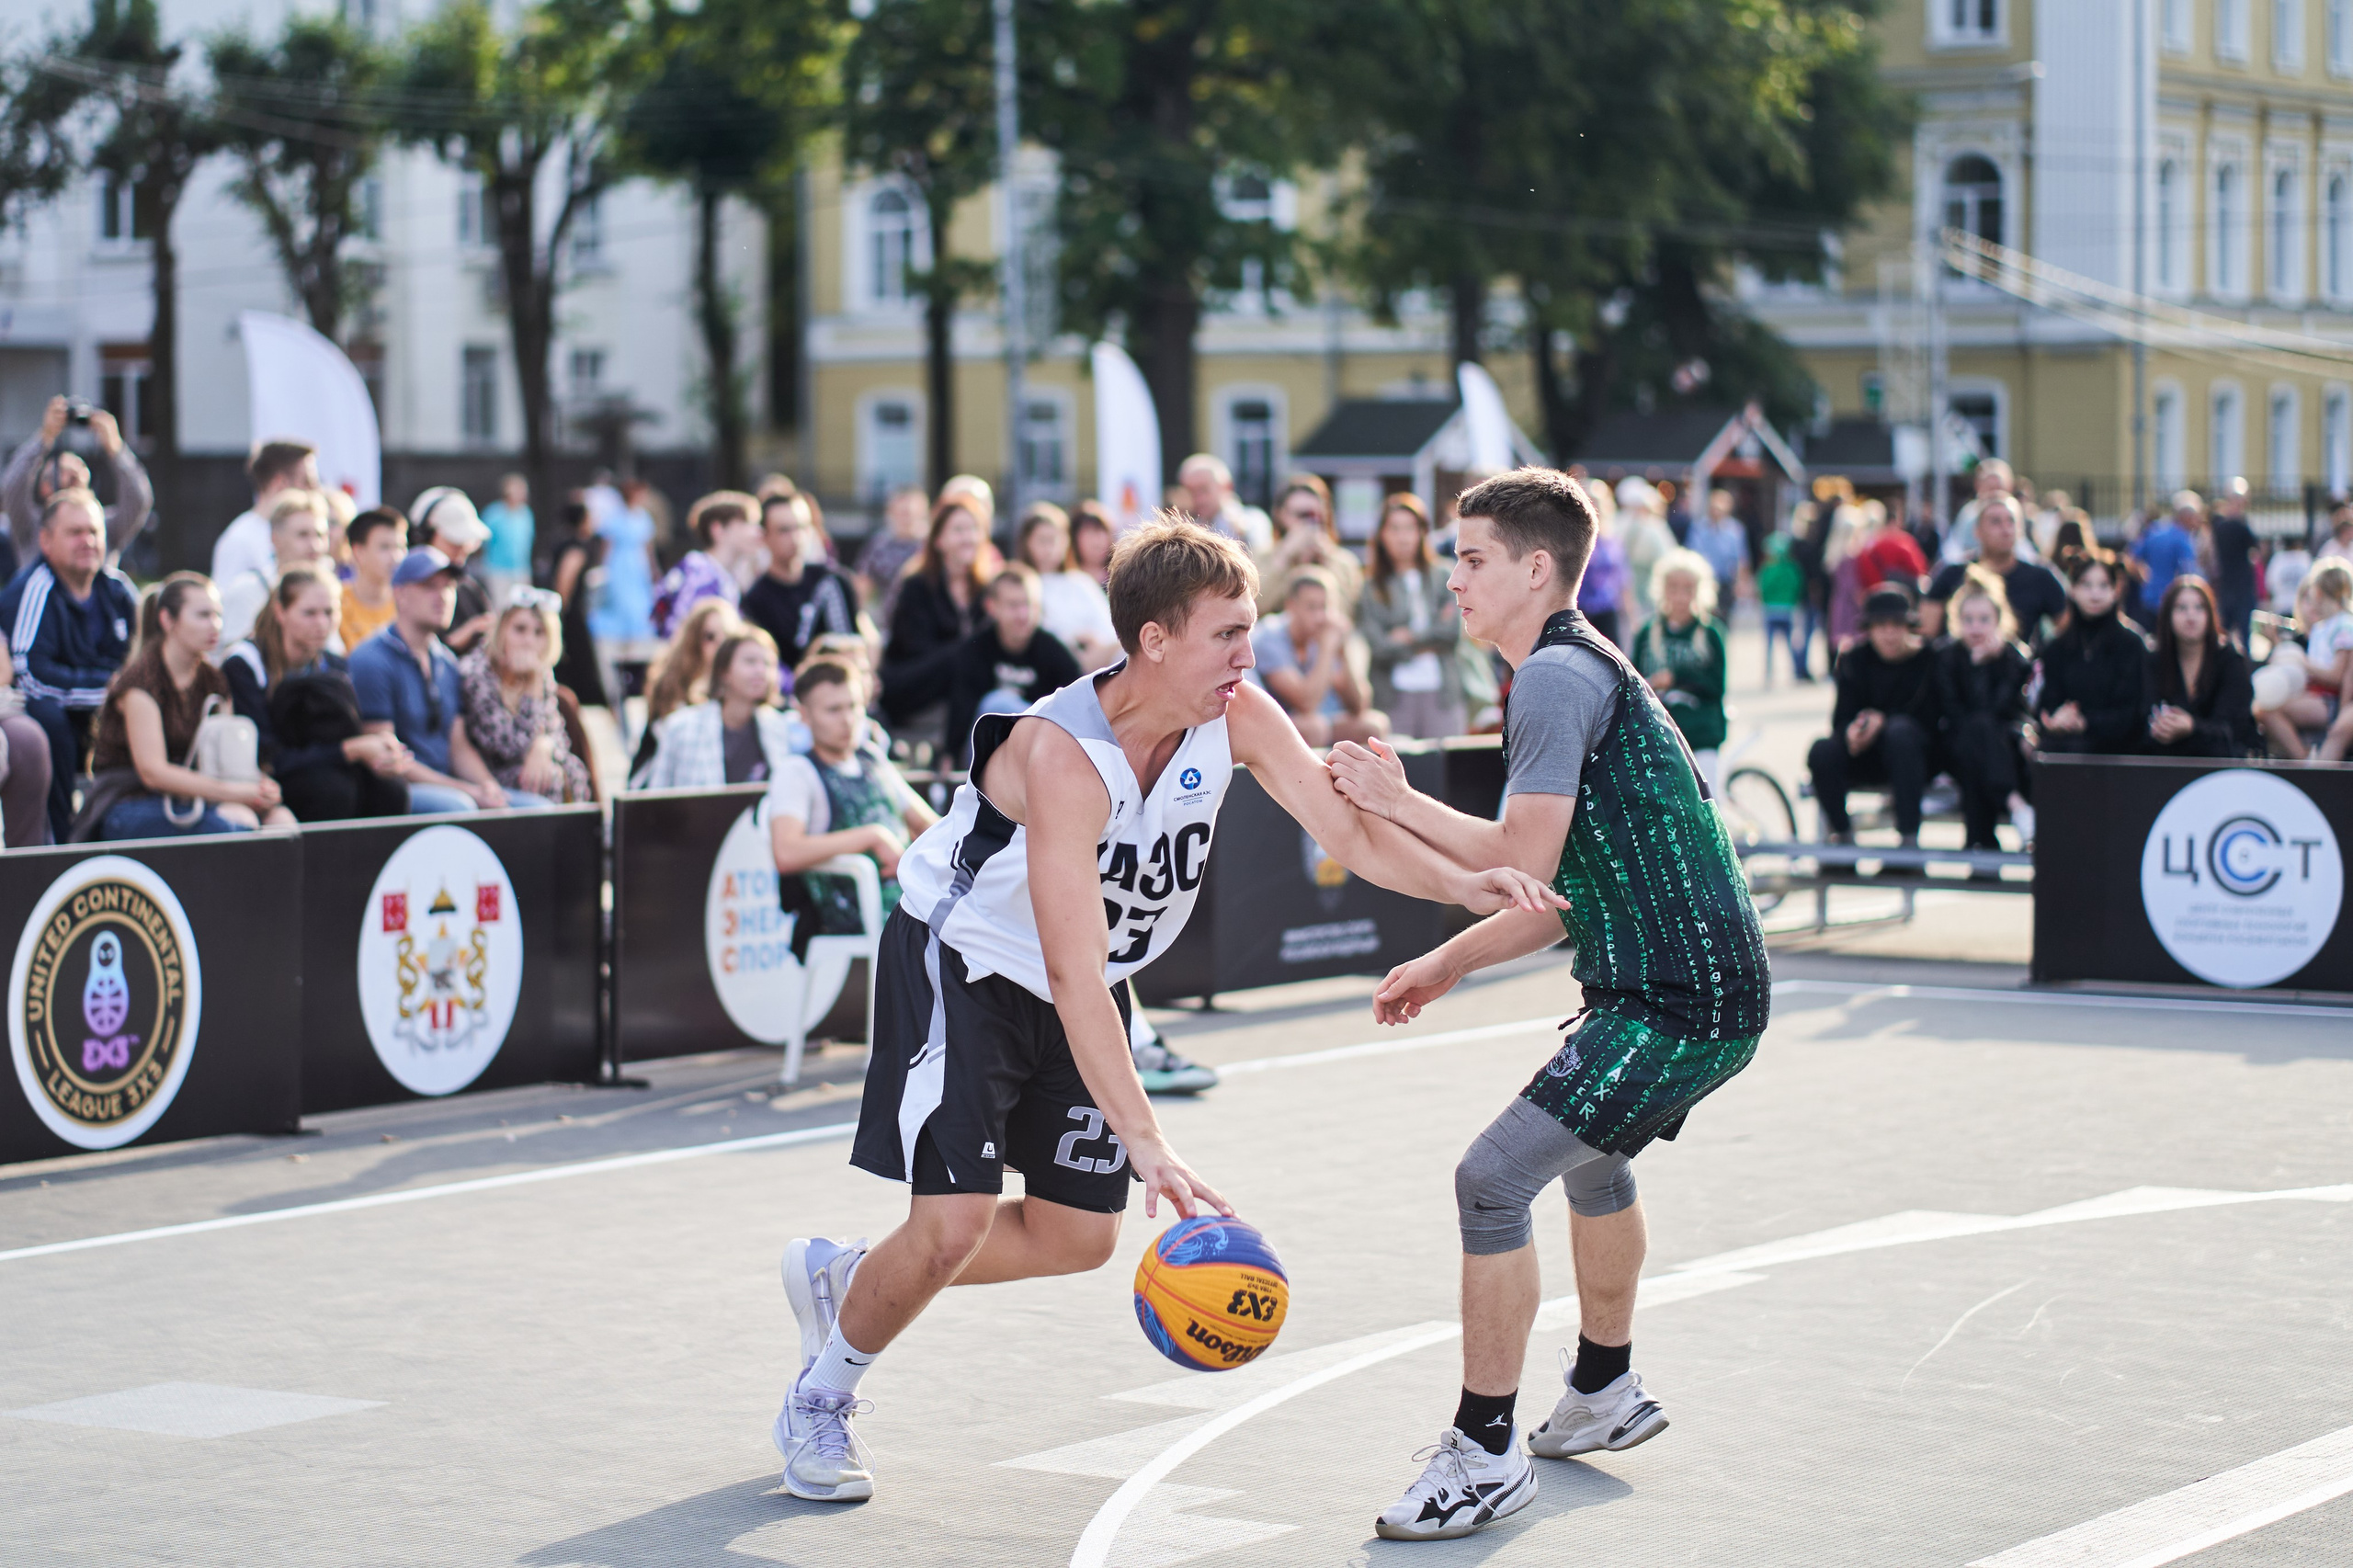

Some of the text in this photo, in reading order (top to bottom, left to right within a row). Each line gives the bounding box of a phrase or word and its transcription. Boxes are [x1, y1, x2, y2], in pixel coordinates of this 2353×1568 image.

[1174, 792, 1202, 801] СМОЛЕНСКАЯ
[1097, 822, 1211, 902] АЭС
[28, 885, 184, 1022] UNITED CONTINENTAL
[47, 1070, 123, 1119] LEAGUE
